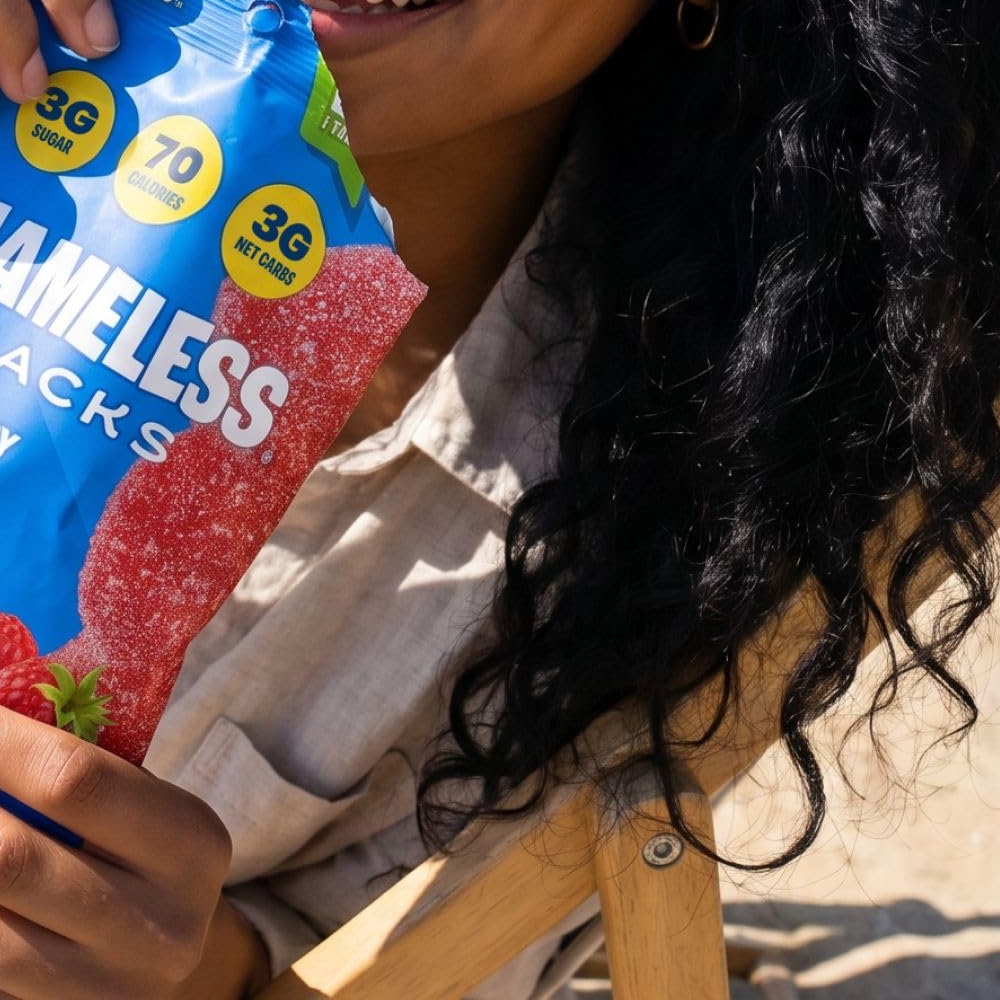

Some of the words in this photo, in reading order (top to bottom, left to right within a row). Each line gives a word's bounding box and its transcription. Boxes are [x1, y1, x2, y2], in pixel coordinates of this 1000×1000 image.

[35, 87, 99, 134] 3G
[31, 123, 73, 155] SUGAR
[145, 133, 204, 184] 70
[128, 170, 185, 211] CALORIES
[252, 204, 312, 261] 3G
[234, 236, 261, 262] NET
[259, 253, 296, 286] CARBS
